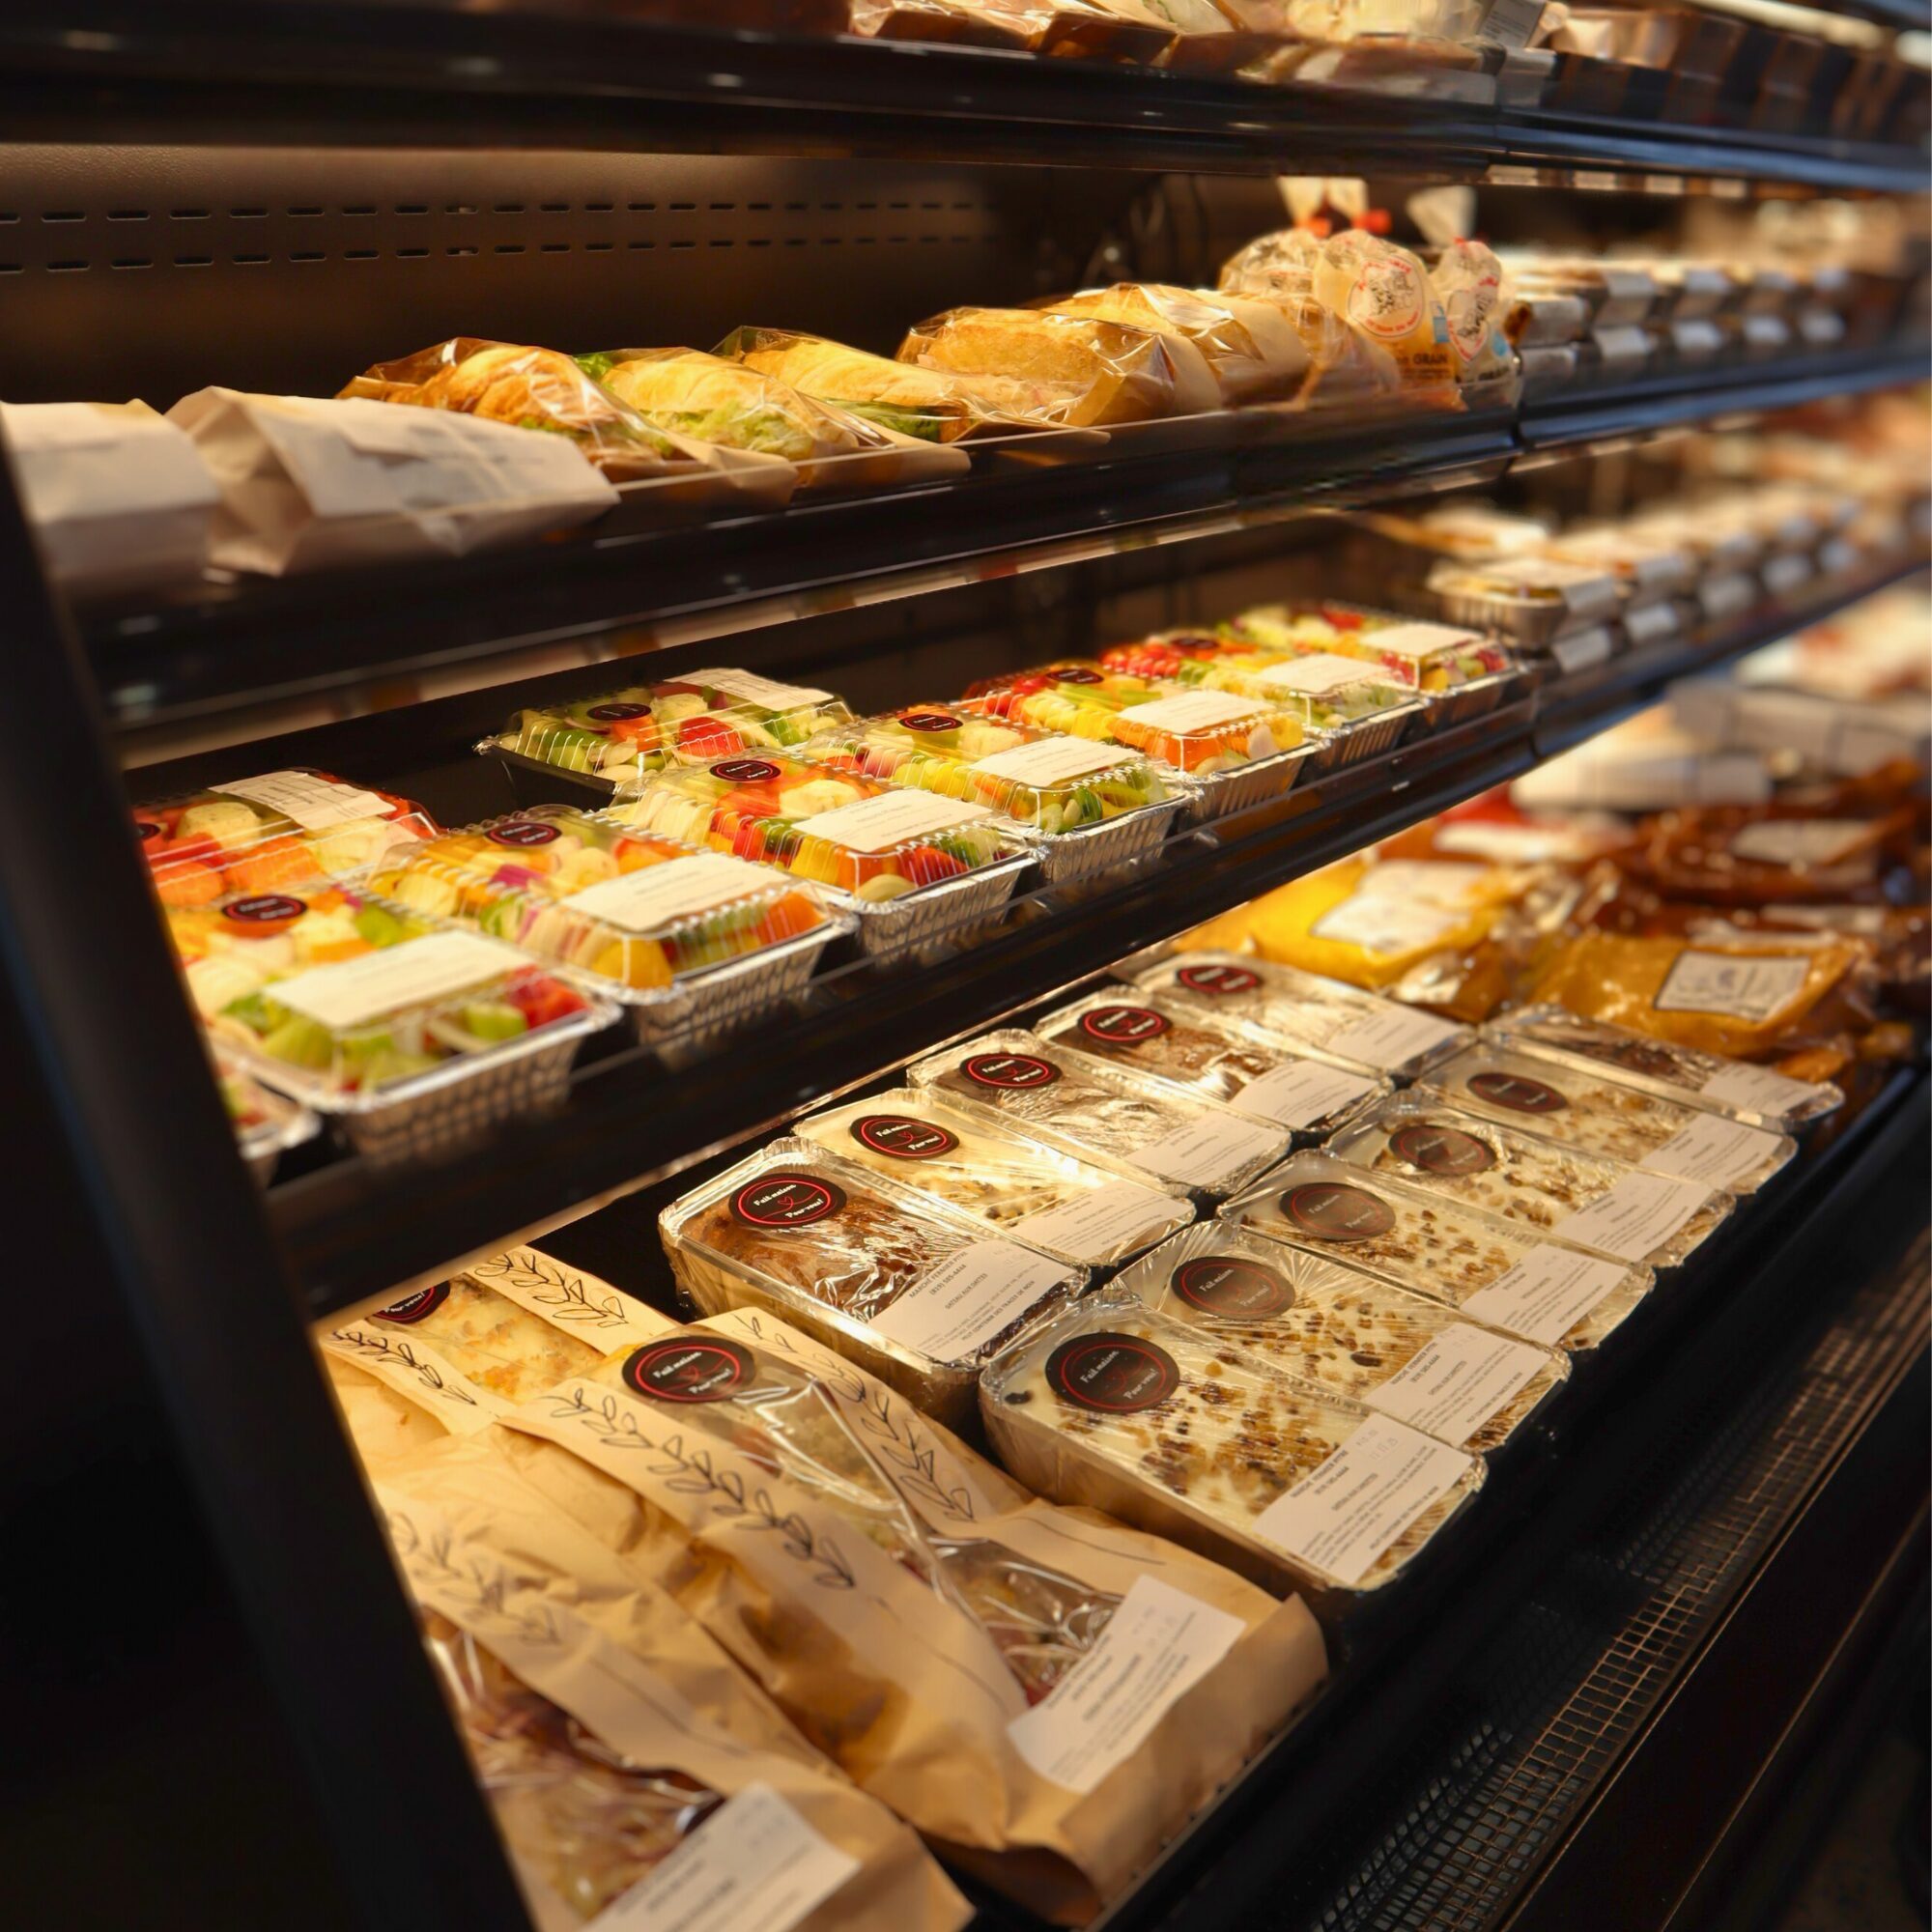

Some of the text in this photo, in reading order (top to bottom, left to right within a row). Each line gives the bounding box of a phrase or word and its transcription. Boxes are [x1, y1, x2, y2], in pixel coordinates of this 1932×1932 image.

[753, 1184, 797, 1207] Fait maison
[784, 1208, 806, 1218] Pour
[652, 1351, 702, 1378] Fait maison
[1080, 1350, 1120, 1383] Fait maison
[688, 1380, 711, 1394] Pour
[1122, 1383, 1143, 1400] Pour
